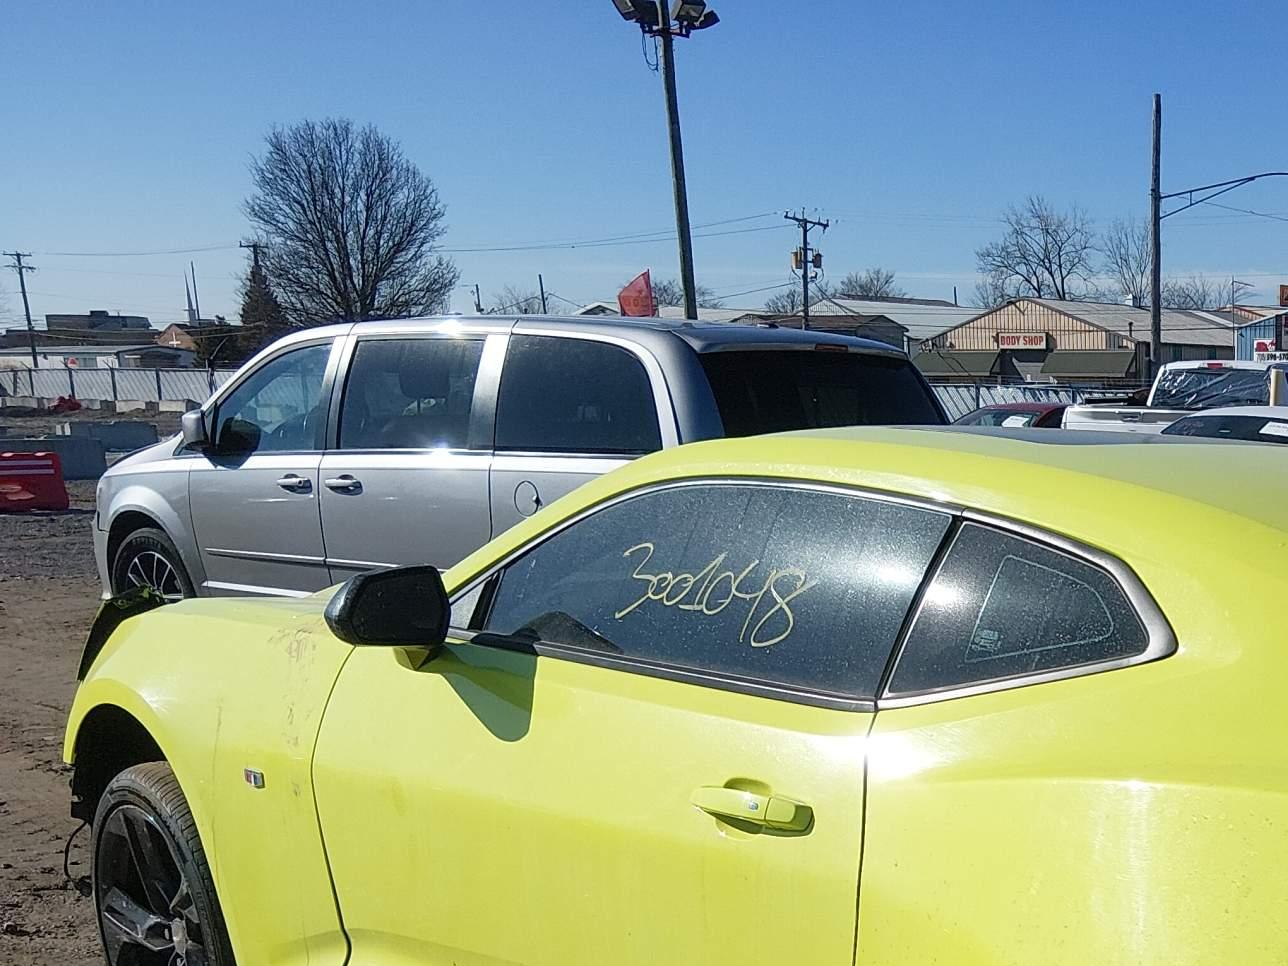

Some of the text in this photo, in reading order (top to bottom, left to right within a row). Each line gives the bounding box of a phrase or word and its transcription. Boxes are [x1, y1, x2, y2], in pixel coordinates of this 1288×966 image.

[1001, 336, 1043, 345] BODY SHOP
[615, 542, 818, 647] 3001048
